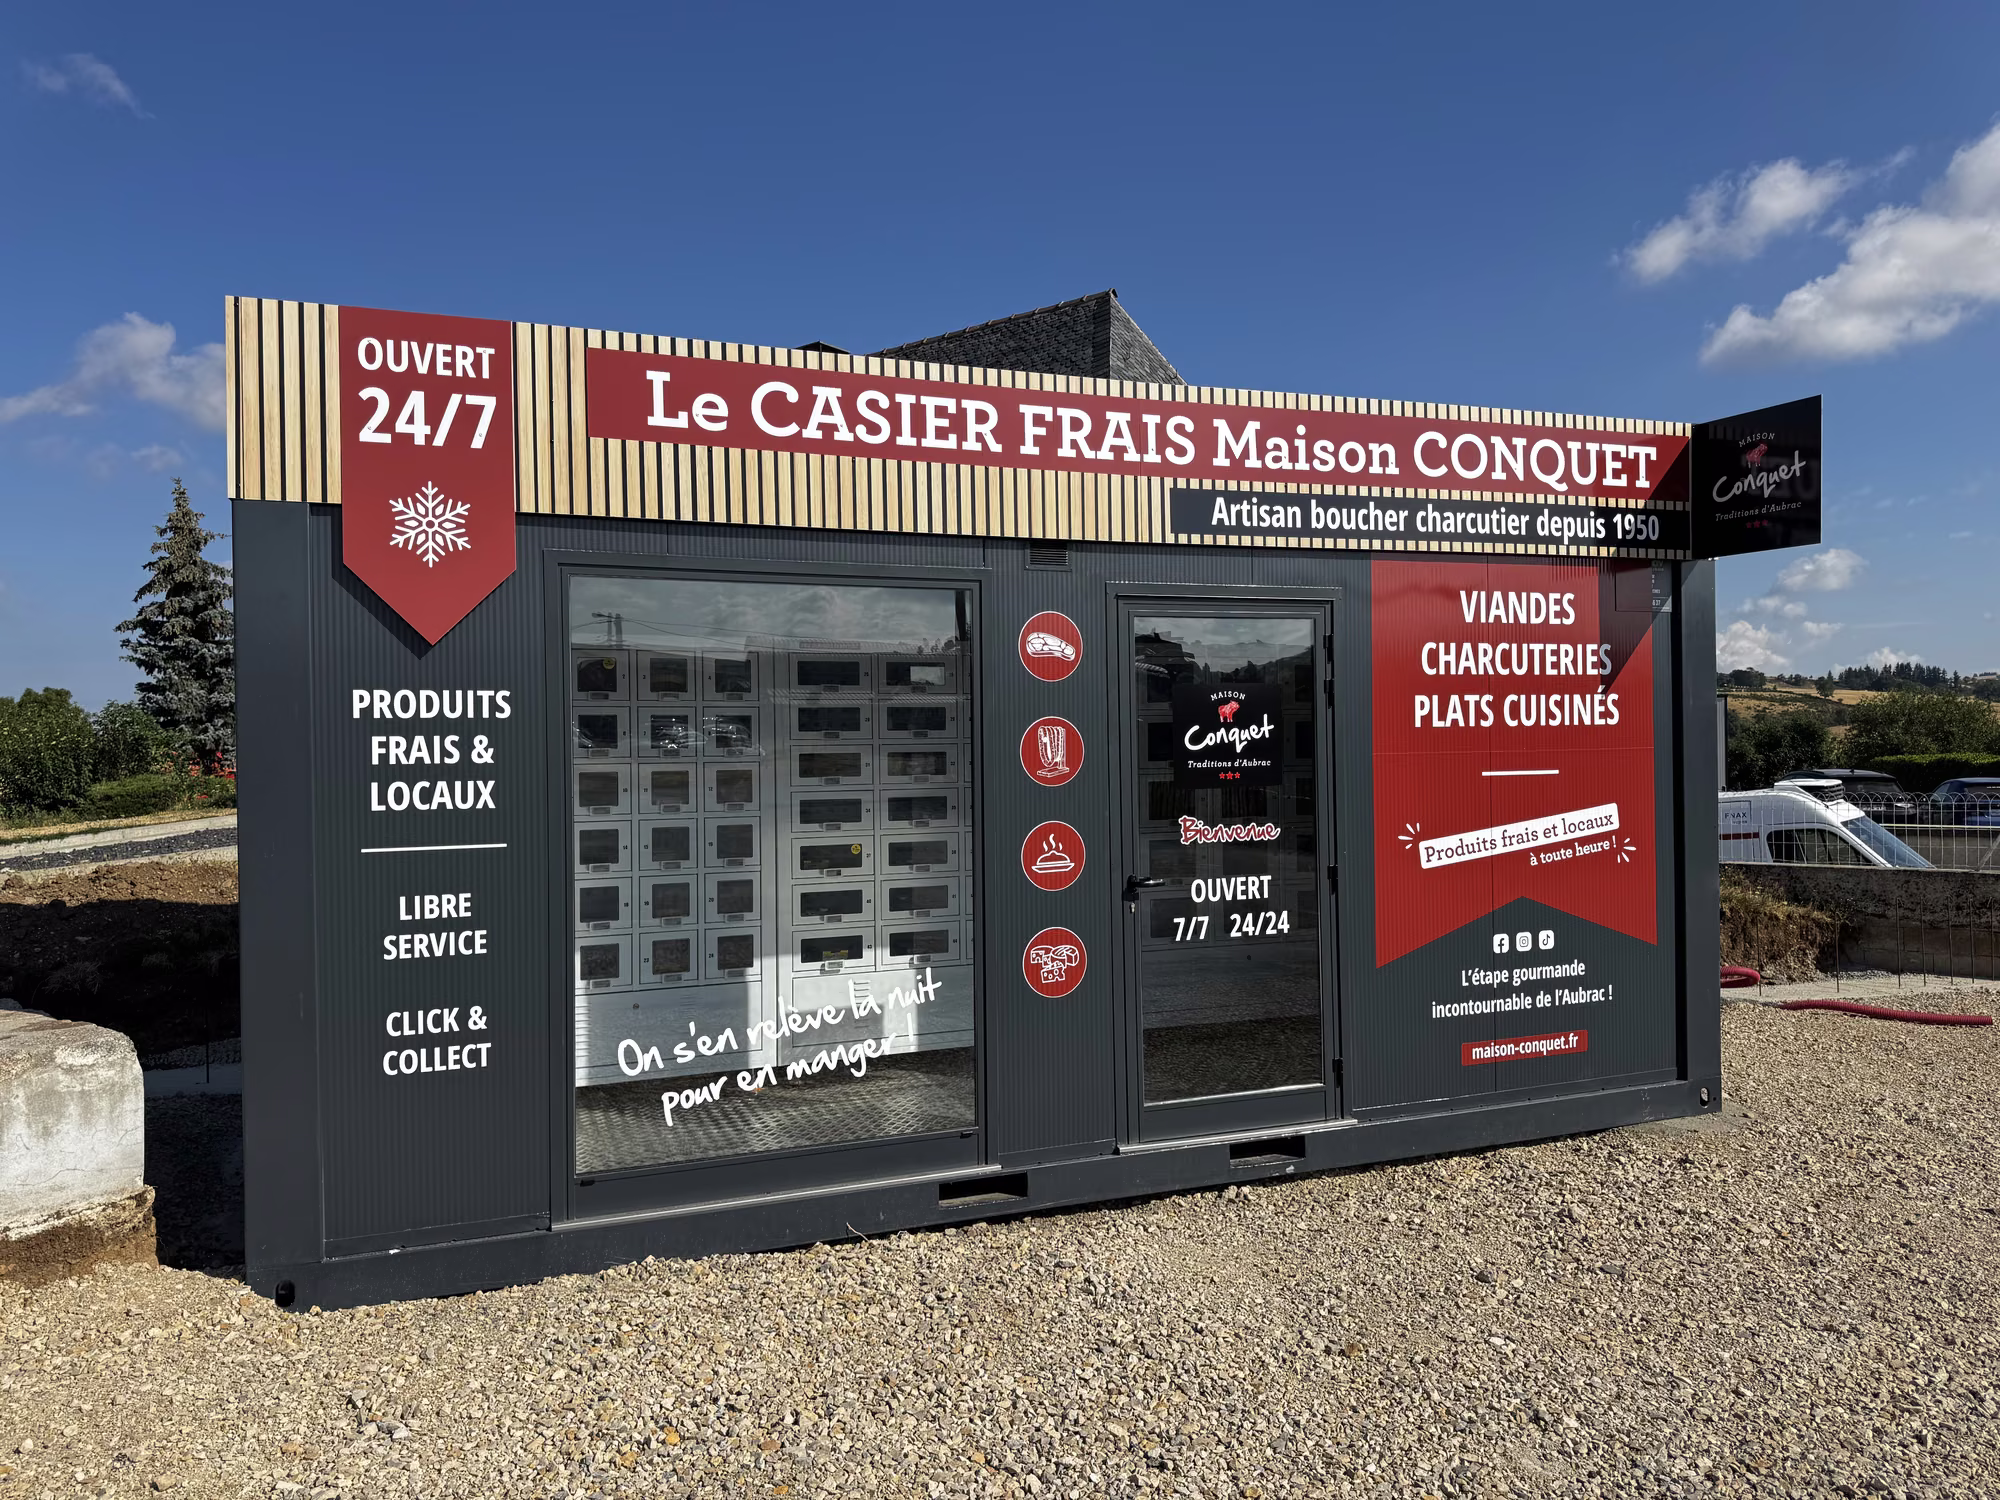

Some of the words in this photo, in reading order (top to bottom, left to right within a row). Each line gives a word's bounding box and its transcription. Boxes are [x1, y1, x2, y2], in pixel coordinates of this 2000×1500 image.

[357, 337, 496, 379] OUVERT
[357, 386, 497, 449] 24/7
[646, 370, 729, 432] Le
[750, 381, 1002, 453] CASIER
[1019, 404, 1196, 465] FRAIS
[1212, 418, 1400, 475] Maison
[1412, 430, 1657, 492] CONQUET
[1739, 432, 1776, 448] MAISON
[1712, 450, 1807, 503] Conquet
[1211, 496, 1302, 529] Artisan
[1310, 499, 1408, 533] boucher
[1415, 504, 1528, 538] charcutier
[1536, 507, 1606, 545] depuis
[1611, 514, 1659, 541] 1950
[1715, 508, 1759, 522] Traditions
[1761, 501, 1802, 514] d'Aubrac
[1460, 590, 1576, 625] VIANDES
[1421, 642, 1612, 676] CHARCUTERIES
[352, 689, 511, 719] PRODUITS
[1210, 690, 1246, 701] MAISON
[1414, 694, 1495, 728] PLATS
[1503, 685, 1620, 727] CUISINÉS
[1184, 713, 1274, 753] Conquet
[371, 735, 460, 765] FRAIS
[471, 734, 495, 763] &
[1188, 760, 1231, 768] Traditions
[1234, 759, 1271, 767] d'Aubrac
[370, 780, 496, 811] LOCAUX
[1179, 815, 1280, 845] Bienvenue
[1424, 839, 1498, 863] Produits
[1501, 829, 1539, 848] frais
[1543, 825, 1559, 838] et
[1561, 813, 1614, 835] locaux
[1530, 853, 1538, 866] à
[1540, 847, 1574, 863] toute
[1575, 841, 1611, 856] heure
[1191, 875, 1272, 903] OUVERT
[399, 893, 472, 921] LIBRE
[1173, 916, 1210, 941] 7/7
[1230, 910, 1290, 938] 24/24
[383, 930, 488, 960] SERVICE
[1461, 969, 1509, 988] L'étape
[1513, 959, 1586, 986] gourmande
[1432, 993, 1532, 1018] incontournable
[1536, 989, 1552, 1007] de
[1555, 986, 1606, 1005] l'Aubrac
[386, 1007, 460, 1037] CLICK
[468, 1005, 488, 1031] &
[617, 1038, 665, 1077] On
[673, 1021, 739, 1064] s'en
[747, 996, 846, 1046] relève
[847, 978, 883, 1020] la
[888, 966, 944, 1011] nuit
[382, 1042, 492, 1076] COLLECT
[1472, 1033, 1579, 1060] maison-conquet.fr
[661, 1076, 728, 1127] pour
[736, 1064, 778, 1092] en
[786, 1031, 899, 1078] manger
[906, 1013, 915, 1043] !
